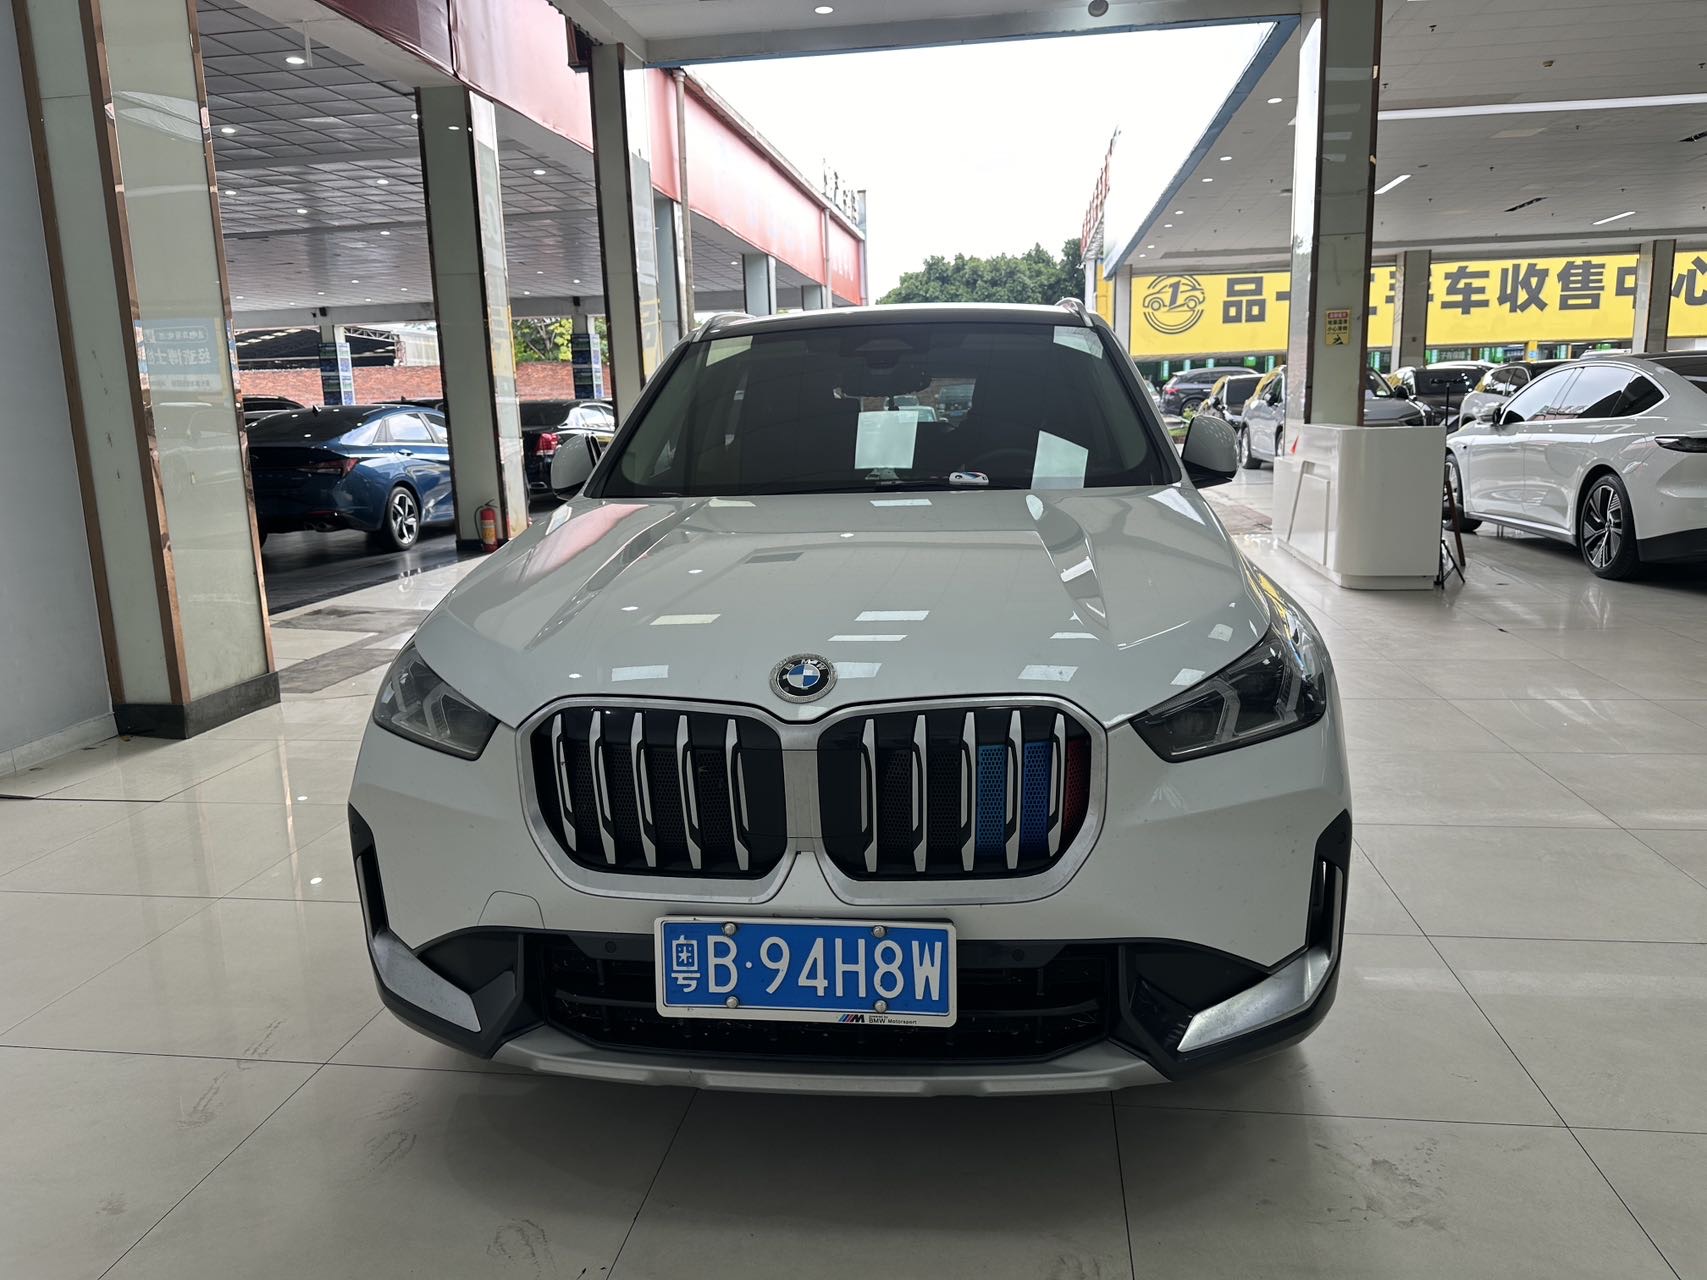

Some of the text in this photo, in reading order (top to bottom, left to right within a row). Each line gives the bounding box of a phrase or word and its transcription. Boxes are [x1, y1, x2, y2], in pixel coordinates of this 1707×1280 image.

[1222, 256, 1707, 324] 品车收售心
[784, 659, 827, 671] BMW
[671, 935, 942, 1001] 粤B·94H8W
